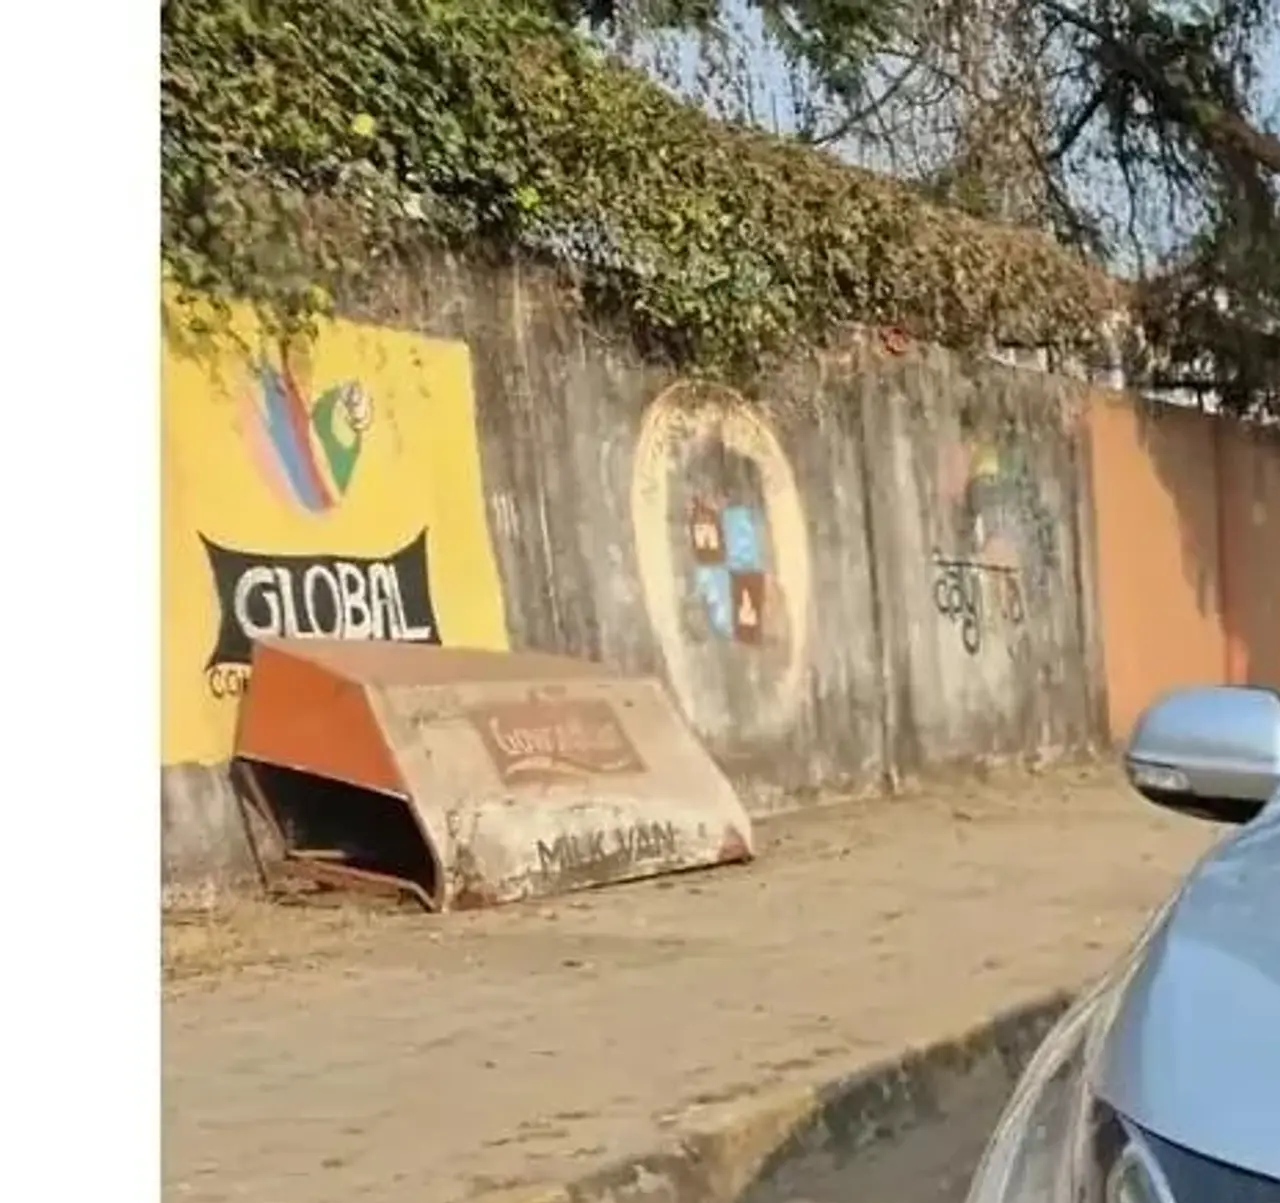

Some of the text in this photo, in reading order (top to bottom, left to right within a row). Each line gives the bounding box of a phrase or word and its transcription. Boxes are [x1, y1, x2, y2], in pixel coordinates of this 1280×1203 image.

[234, 562, 431, 641] GLOBAL
[537, 820, 676, 872] MILK VAN
